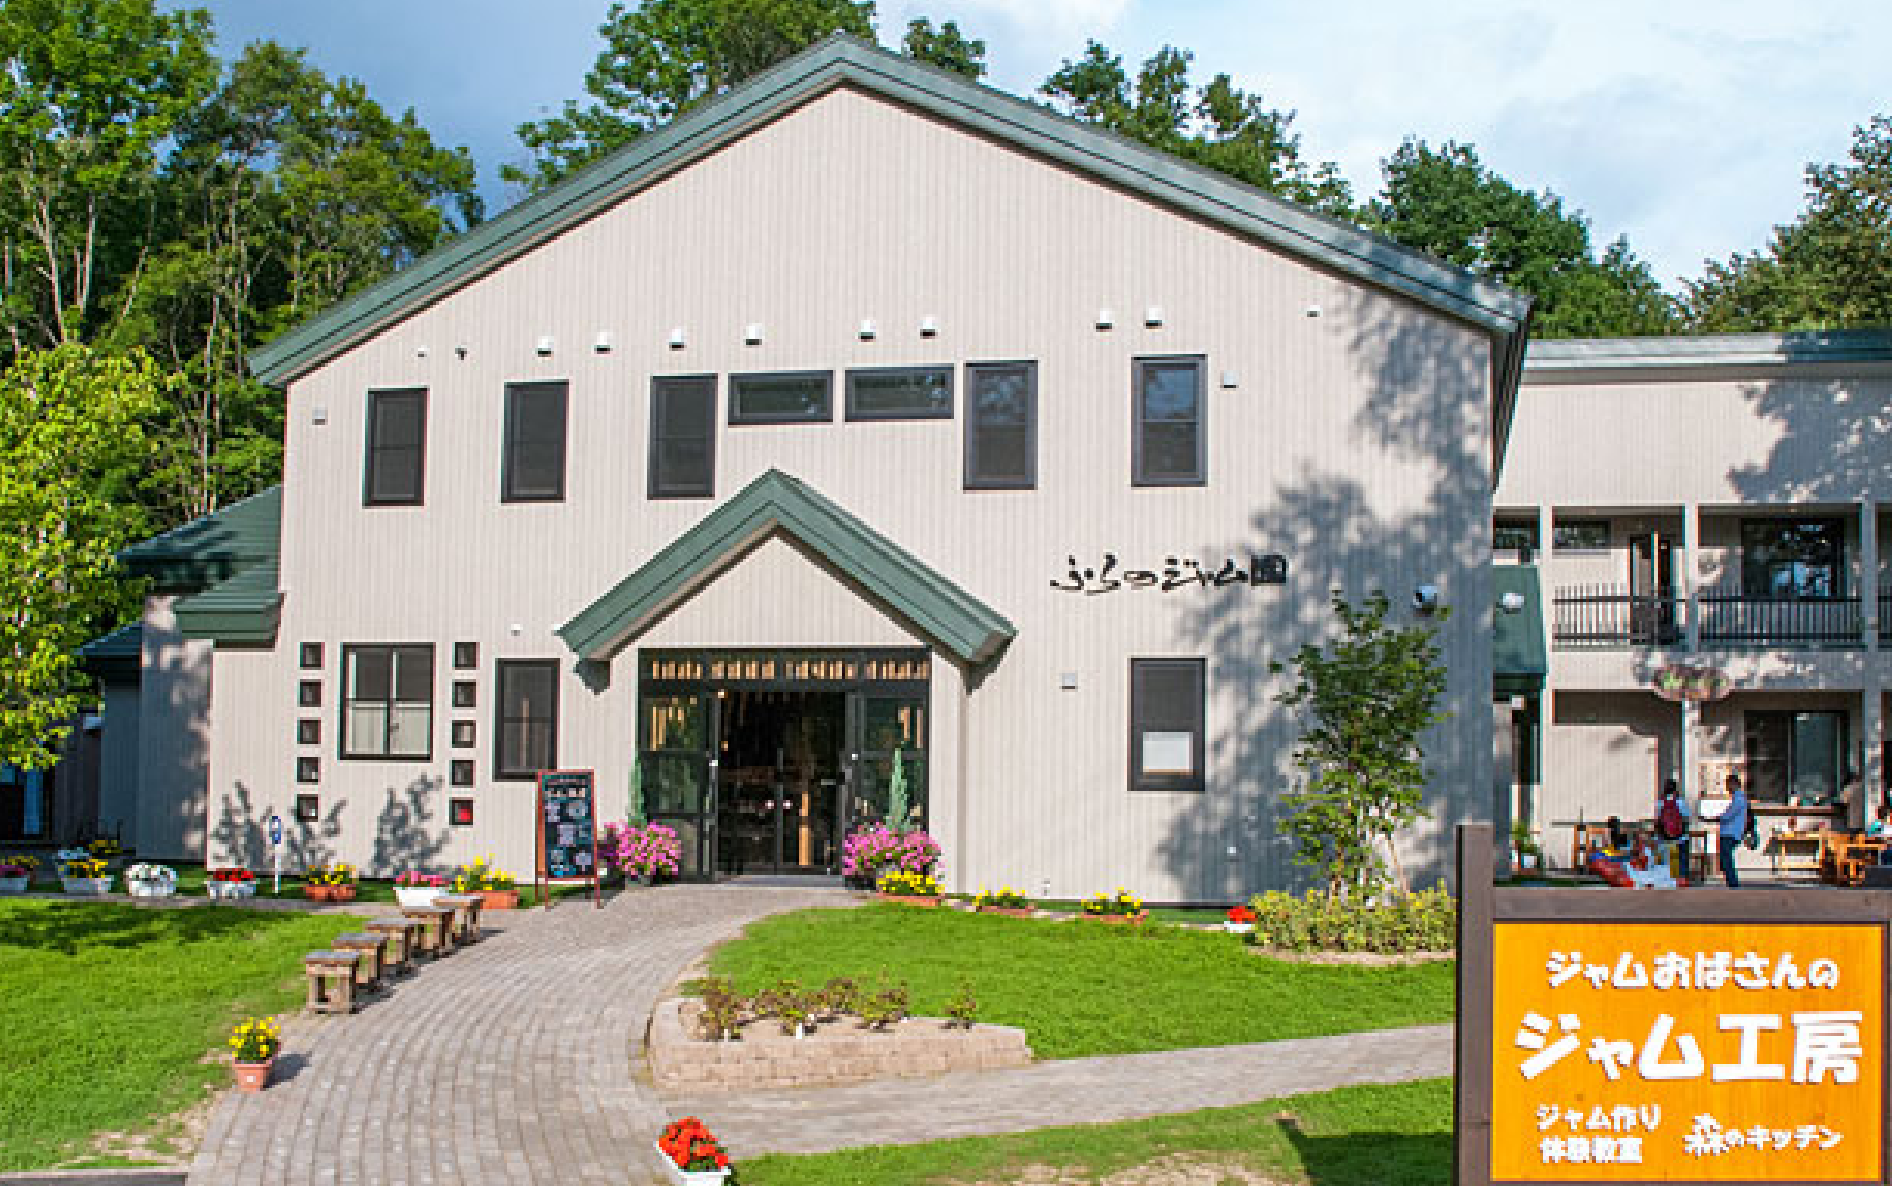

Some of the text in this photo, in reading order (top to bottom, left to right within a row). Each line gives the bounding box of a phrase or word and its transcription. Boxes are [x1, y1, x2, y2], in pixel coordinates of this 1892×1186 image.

[1547, 951, 1840, 989] ジャムおばさんの
[1515, 1010, 1863, 1084] ジャム工房
[1537, 1104, 1661, 1131] ジャム作り
[1682, 1112, 1844, 1158] 森のキッチン
